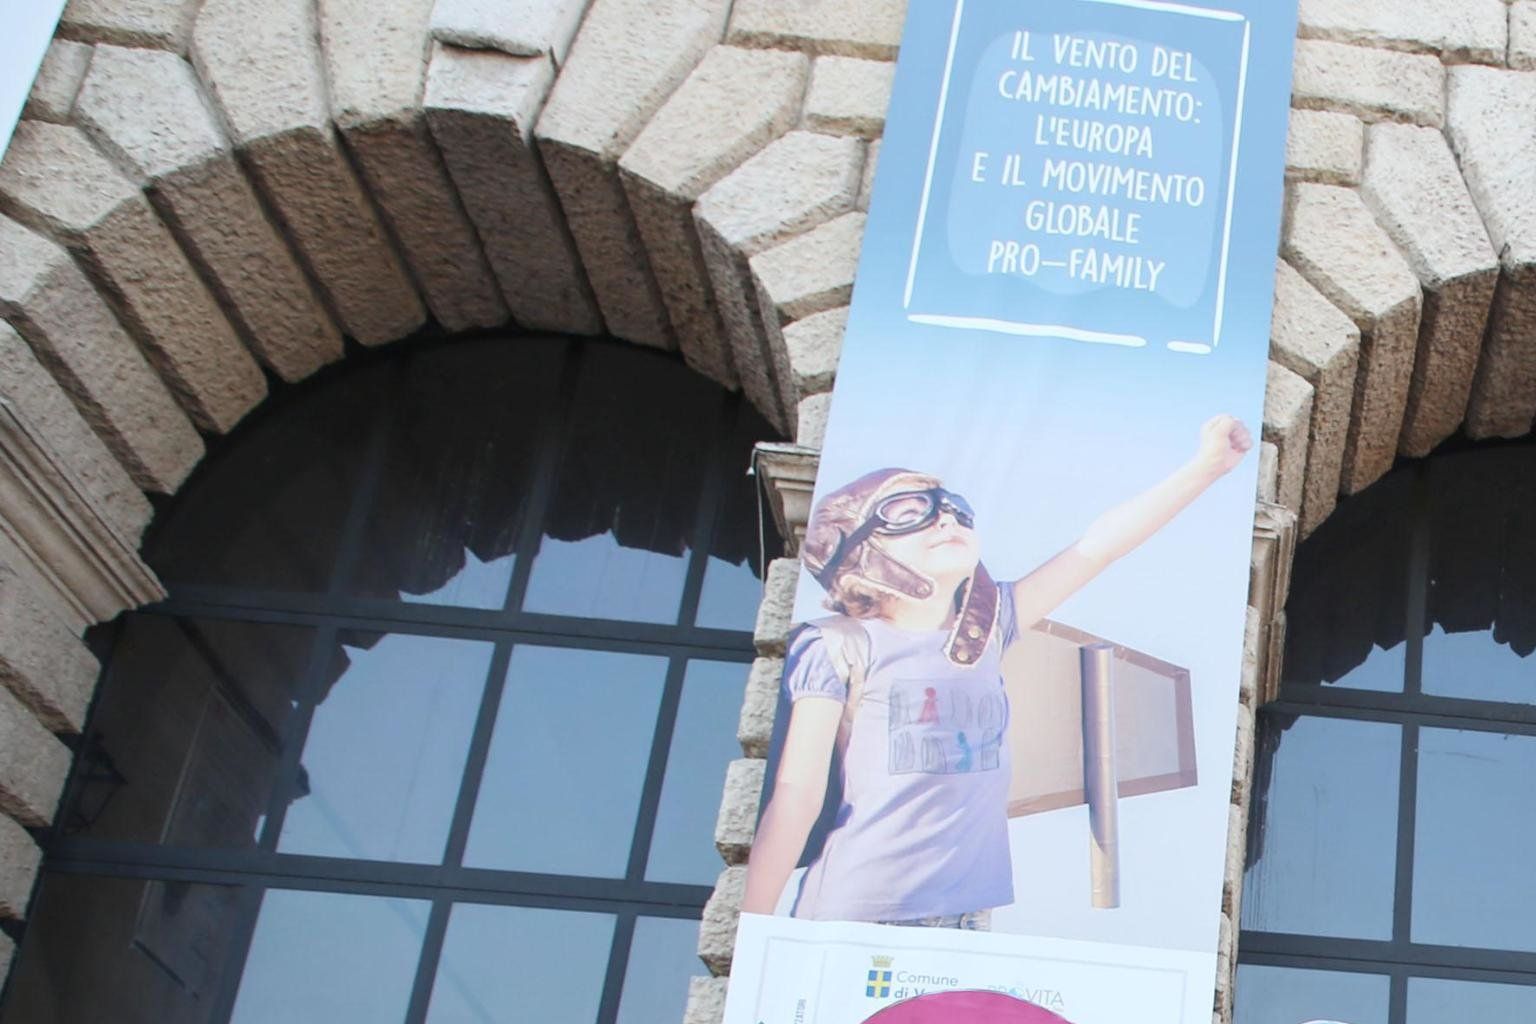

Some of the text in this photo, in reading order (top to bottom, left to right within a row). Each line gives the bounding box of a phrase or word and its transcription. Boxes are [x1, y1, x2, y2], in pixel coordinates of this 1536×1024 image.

[1011, 31, 1198, 83] IL VENTO DEL
[999, 70, 1203, 125] CAMBIAMENTO:
[1035, 114, 1154, 159] L'EUROPA
[972, 152, 1204, 207] E IL MOVIMENTO
[1025, 201, 1142, 244] GLOBALE
[896, 971, 959, 987] Comune
